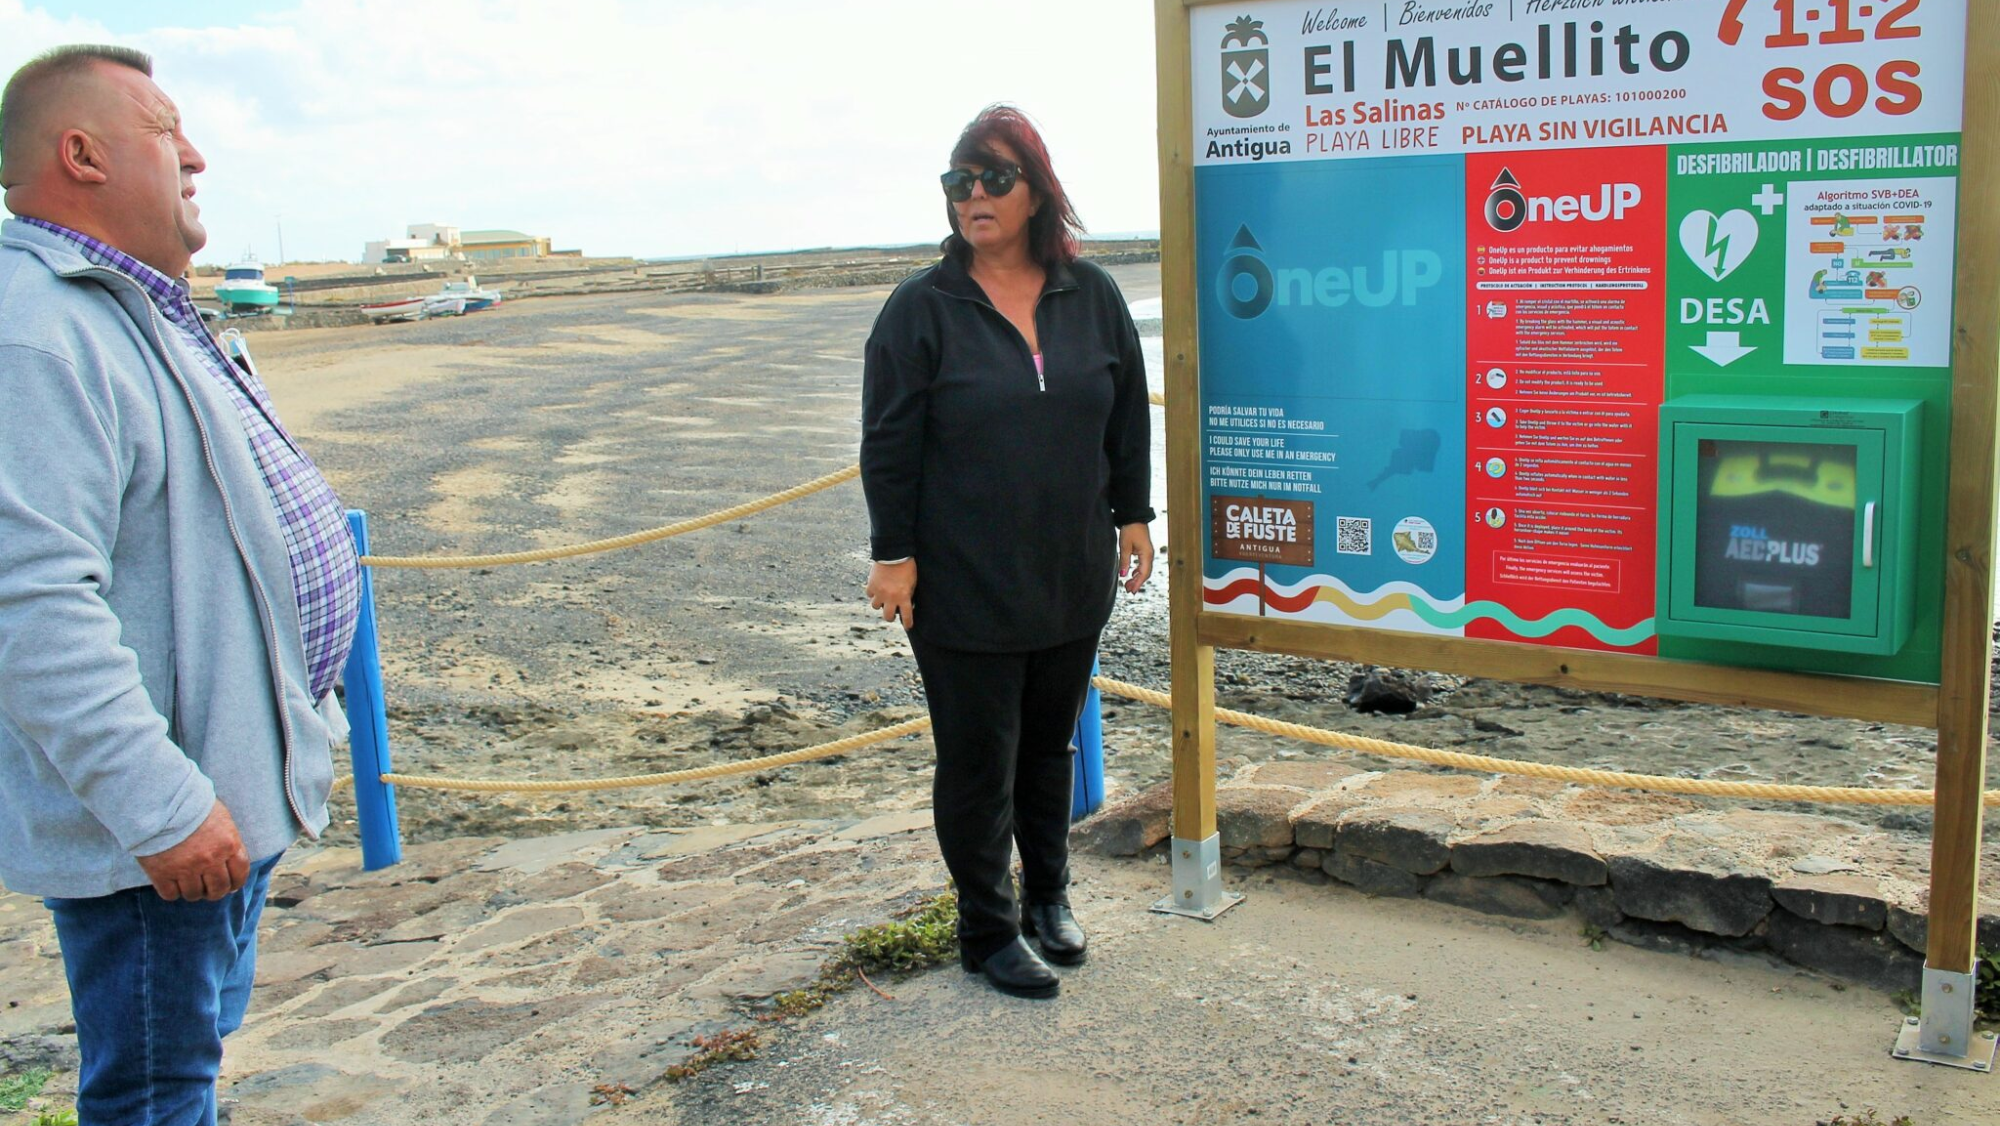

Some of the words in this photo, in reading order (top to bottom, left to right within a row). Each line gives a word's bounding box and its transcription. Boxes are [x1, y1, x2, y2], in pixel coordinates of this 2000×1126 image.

[1399, 0, 1493, 25] Bienvenidos
[1301, 10, 1368, 35] Welcome
[1304, 40, 1355, 95] El
[1385, 20, 1690, 90] Muellito
[1762, 60, 1922, 121] SOS
[1473, 95, 1537, 110] CATÁLOGO
[1541, 95, 1557, 107] DE
[1561, 92, 1611, 105] PLAYAS:
[1615, 88, 1687, 102] 101000200
[1305, 105, 1346, 128] Las
[1353, 99, 1445, 125] Salinas
[1207, 125, 1274, 137] Ayuntamiento
[1278, 123, 1290, 133] de
[1462, 123, 1531, 145] PLAYA
[1539, 121, 1576, 141] SIN
[1583, 113, 1728, 139] VIGILANCIA
[1306, 129, 1370, 153] PLAYA
[1382, 126, 1439, 149] LIBRE
[1206, 138, 1291, 161] Antigua
[1677, 151, 1801, 175] DESFIBRILADOR
[1817, 145, 1957, 171] DESFIBRILLATOR
[1817, 191, 1868, 202] Algoritmo
[1872, 189, 1919, 199] SVB+DEA
[1804, 203, 1842, 212] adaptado
[1852, 202, 1890, 210] situación
[1893, 201, 1932, 209] COVID-19
[1476, 304, 1481, 315] 1
[1680, 297, 1770, 325] DESA
[1475, 373, 1481, 384] 2
[1209, 405, 1231, 415] PODRÍA
[1233, 407, 1257, 416] SALVAR
[1258, 407, 1267, 416] TU
[1268, 408, 1284, 417] VIDA
[1475, 412, 1482, 423] 3
[1209, 418, 1218, 426] NO
[1219, 418, 1228, 427] ME
[1230, 418, 1257, 428] UTILICES
[1259, 419, 1266, 428] SI
[1267, 420, 1276, 428] NO
[1278, 420, 1286, 429] ES
[1288, 420, 1324, 430] NECESARIO
[1209, 435, 1212, 444] I
[1213, 435, 1233, 445] COULD
[1234, 436, 1250, 446] SAVE
[1252, 437, 1269, 447] YOUR
[1270, 438, 1284, 448] LIFE
[1210, 447, 1232, 457] PLEASE
[1234, 448, 1250, 457] ONLY
[1252, 449, 1263, 458] USE
[1265, 449, 1275, 459] ME
[1276, 450, 1284, 459] IN
[1285, 450, 1294, 460] AN
[1296, 451, 1336, 462] EMERGENCY
[1210, 466, 1220, 476] ICH
[1222, 466, 1246, 477] KÖNNTE
[1248, 468, 1263, 478] DEIN
[1264, 469, 1285, 479] LEBEN
[1287, 471, 1312, 481] RETTEN
[1474, 461, 1481, 472] 4
[1210, 478, 1228, 488] BITTE
[1229, 479, 1249, 489] NUTZE
[1250, 480, 1267, 490] MICH
[1268, 481, 1282, 491] NUR
[1283, 482, 1291, 491] IM
[1293, 482, 1322, 493] NOTFALL
[1226, 504, 1296, 525] CALETA
[1474, 511, 1481, 523] 5
[1226, 521, 1240, 534] DE
[1244, 522, 1296, 542] FUSTE
[1730, 525, 1768, 539] ZOLL
[1240, 543, 1280, 553] ANTIGUA
